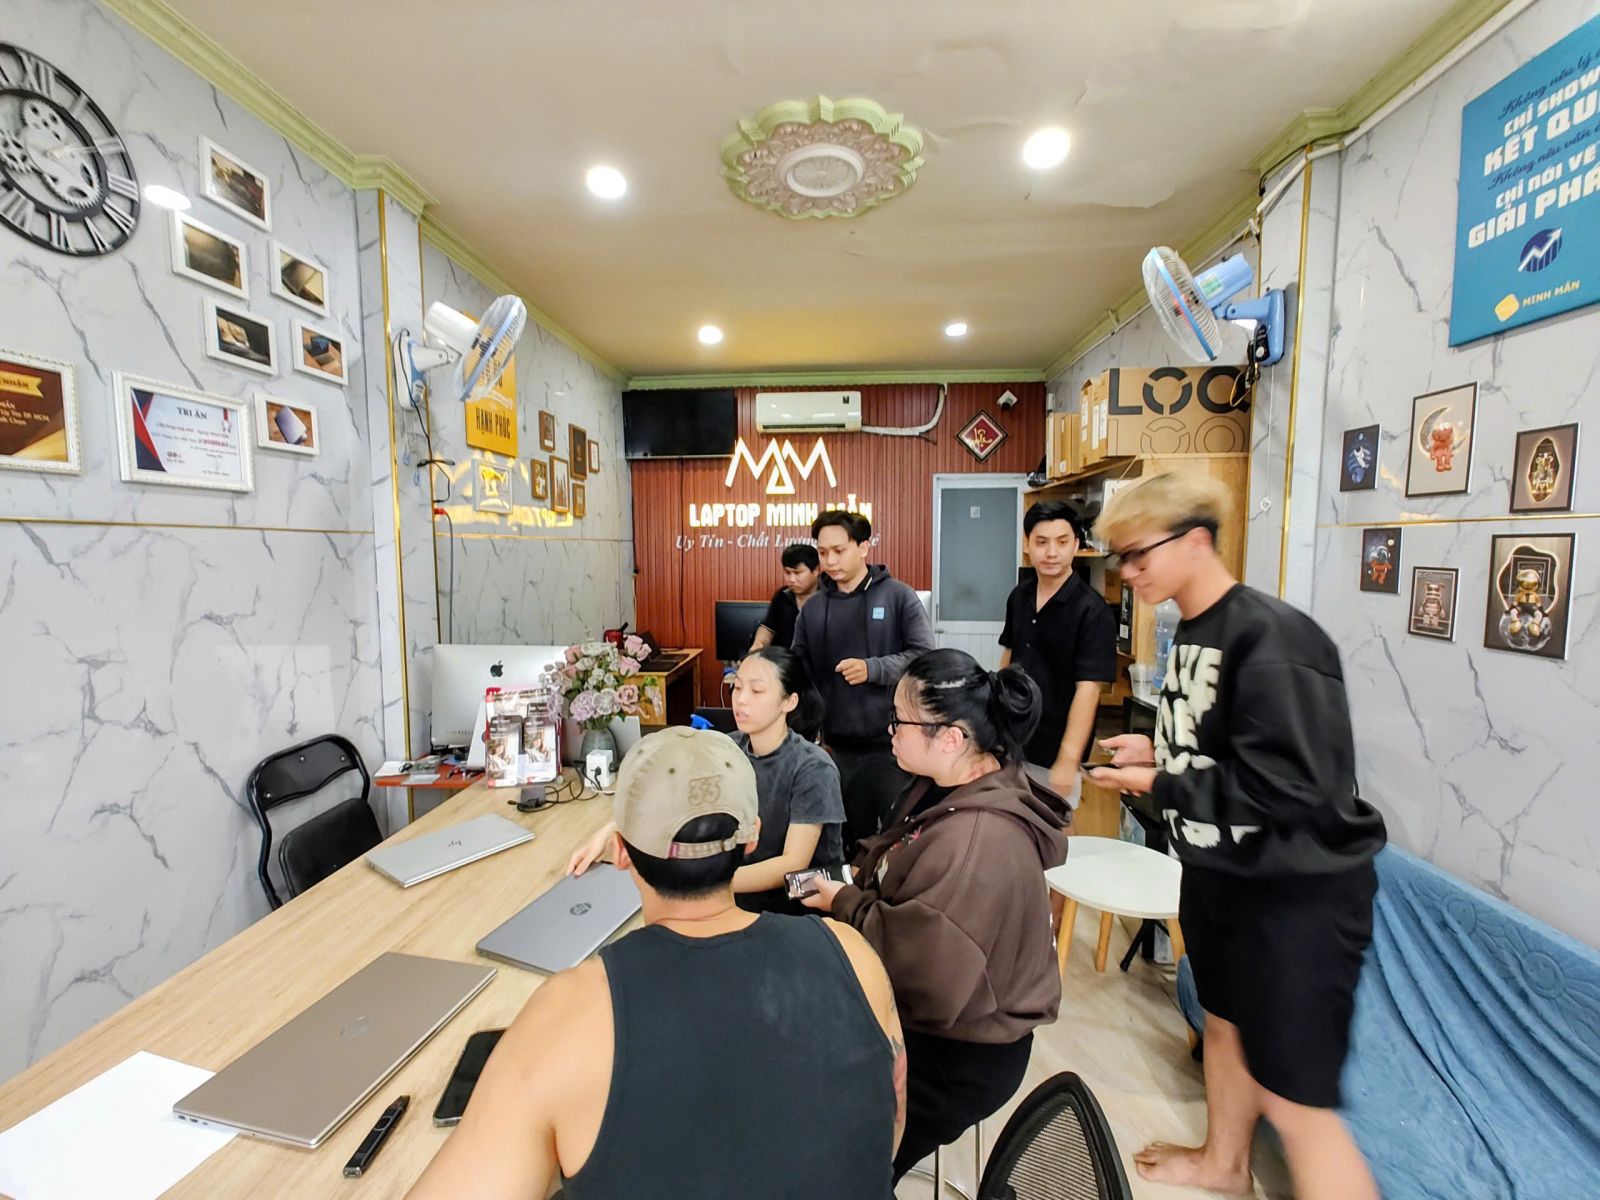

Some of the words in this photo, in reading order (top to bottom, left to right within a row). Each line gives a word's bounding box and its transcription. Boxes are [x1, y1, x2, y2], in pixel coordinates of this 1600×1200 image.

[1546, 88, 1600, 141] QU
[1522, 289, 1552, 308] MINH
[1109, 366, 1250, 415] LOQ
[177, 407, 193, 417] TRI
[689, 503, 760, 527] LAPTOP
[766, 502, 818, 527] MINH
[676, 534, 695, 551] Uy
[700, 533, 724, 548] Tín
[737, 531, 769, 548] Chất
